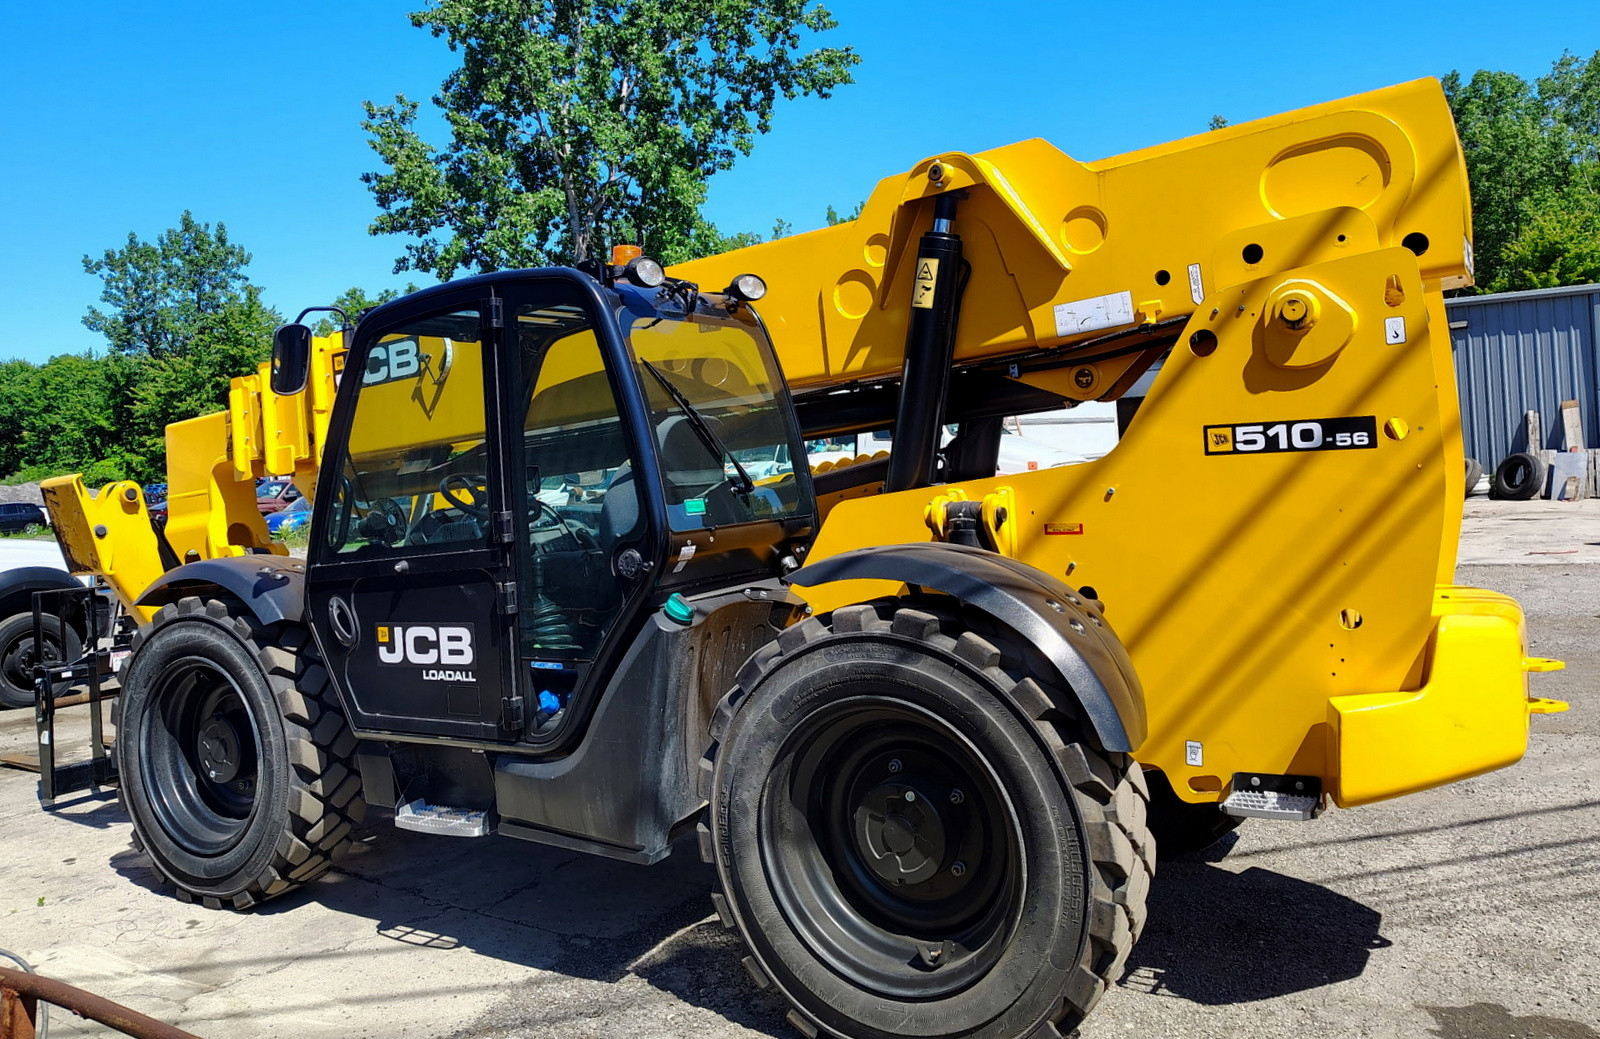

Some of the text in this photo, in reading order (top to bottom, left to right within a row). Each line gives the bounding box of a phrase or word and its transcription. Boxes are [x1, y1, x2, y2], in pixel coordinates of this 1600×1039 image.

[335, 340, 419, 387] CB
[378, 626, 474, 665] JCB
[422, 669, 477, 682] LOADALL
